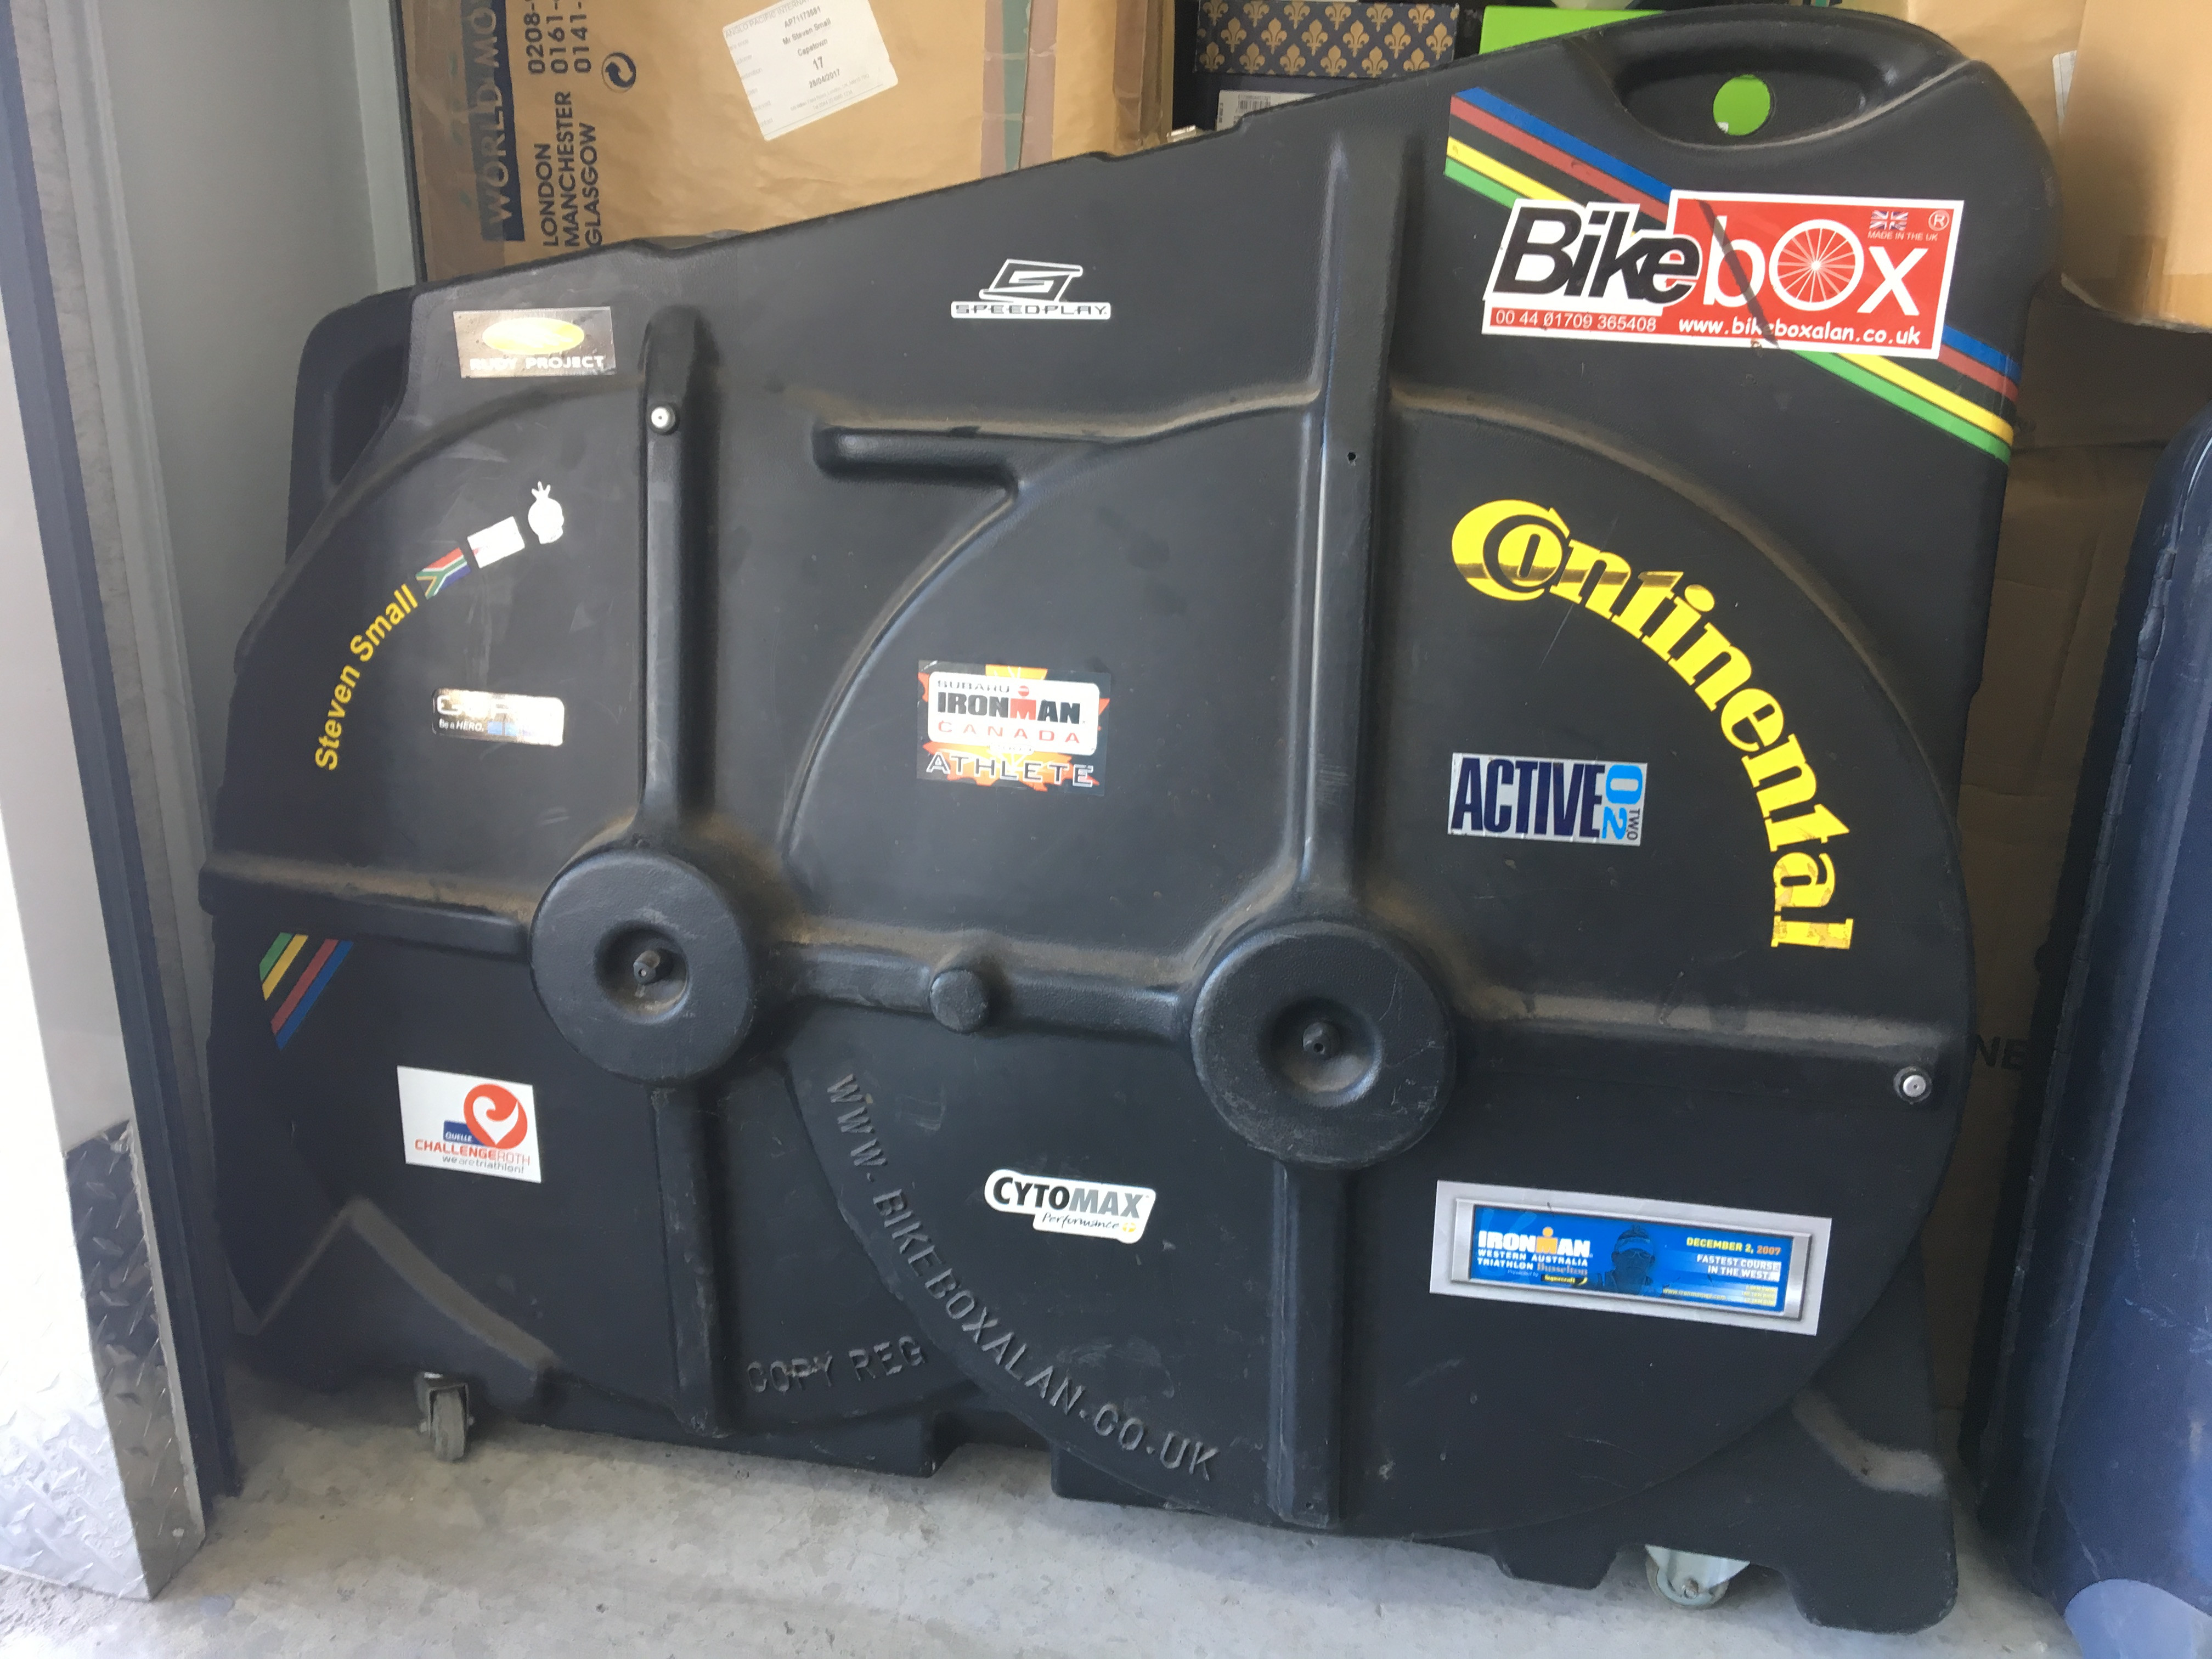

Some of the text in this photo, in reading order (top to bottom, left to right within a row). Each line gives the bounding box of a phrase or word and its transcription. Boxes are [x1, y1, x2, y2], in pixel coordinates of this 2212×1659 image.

[749, 10, 776, 27] PACIFIC
[777, 0, 809, 15] INTERNA
[792, 27, 813, 41] Steven
[814, 18, 831, 31] Small
[798, 38, 828, 57] Capetown
[813, 55, 823, 70] 17
[809, 69, 840, 88] 28/04/2017
[524, 0, 558, 246] LONDON 0208-
[546, 0, 580, 246] MANCHESTER 0161-
[475, 78, 512, 224] WORLD
[579, 122, 602, 246] GLASGOW
[1867, 230, 1938, 241] MADE IN THE UK
[956, 304, 1107, 315] SPEEDPLAY
[1496, 309, 1515, 325] 00
[1519, 311, 1538, 326] 44
[1598, 314, 1656, 332] 365408
[470, 355, 606, 370] RUDY PROJECT
[315, 584, 418, 770] Steven Small
[938, 685, 1081, 725] IRONMAN
[938, 719, 1080, 744] CANADA
[1452, 499, 1854, 949] Continental
[926, 752, 1094, 788] ATHLETE
[1451, 757, 1606, 839] ACTIVE
[445, 1131, 472, 1142] QUELLE
[993, 1176, 1144, 1218] CYTOMAX
[1042, 1211, 1120, 1229] Performance
[1478, 1227, 1590, 1257] IRONMAN
[1686, 1237, 1743, 1252] DECEMBER
[1757, 1245, 1781, 1256] 2007
[1477, 1257, 1533, 1270] TRIATHLON
[1478, 1249, 1588, 1267] WESTERN AUSTRALIA
[1697, 1254, 1779, 1271] FASTEST COURSE
[1708, 1265, 1718, 1274] IN
[1720, 1266, 1738, 1276] THE
[747, 1335, 926, 1393] COPY REG
